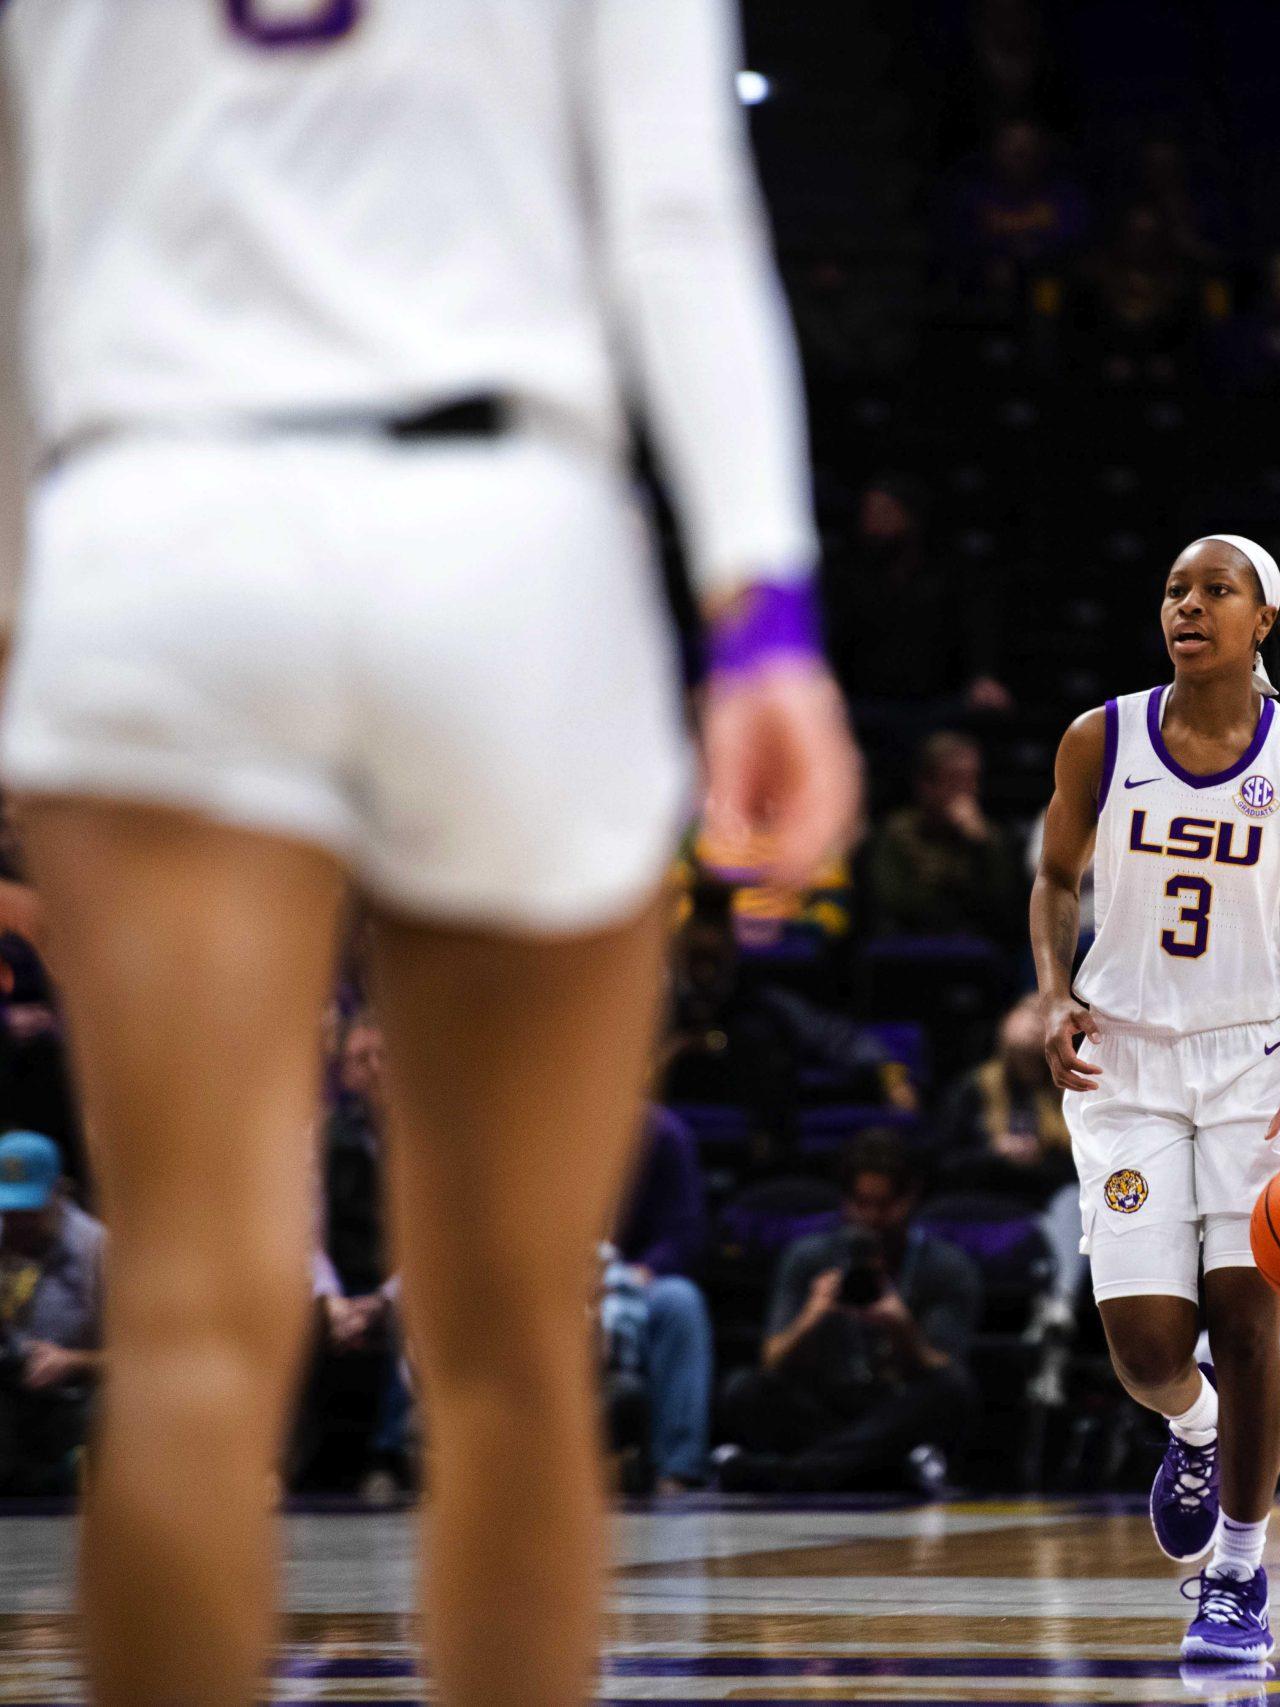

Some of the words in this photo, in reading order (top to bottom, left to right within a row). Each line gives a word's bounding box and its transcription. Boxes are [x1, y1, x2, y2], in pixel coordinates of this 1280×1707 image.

[1237, 801, 1274, 817] GRADUATE
[1244, 776, 1273, 807] SEC
[1129, 809, 1263, 867] LSU
[1160, 873, 1214, 960] 3
